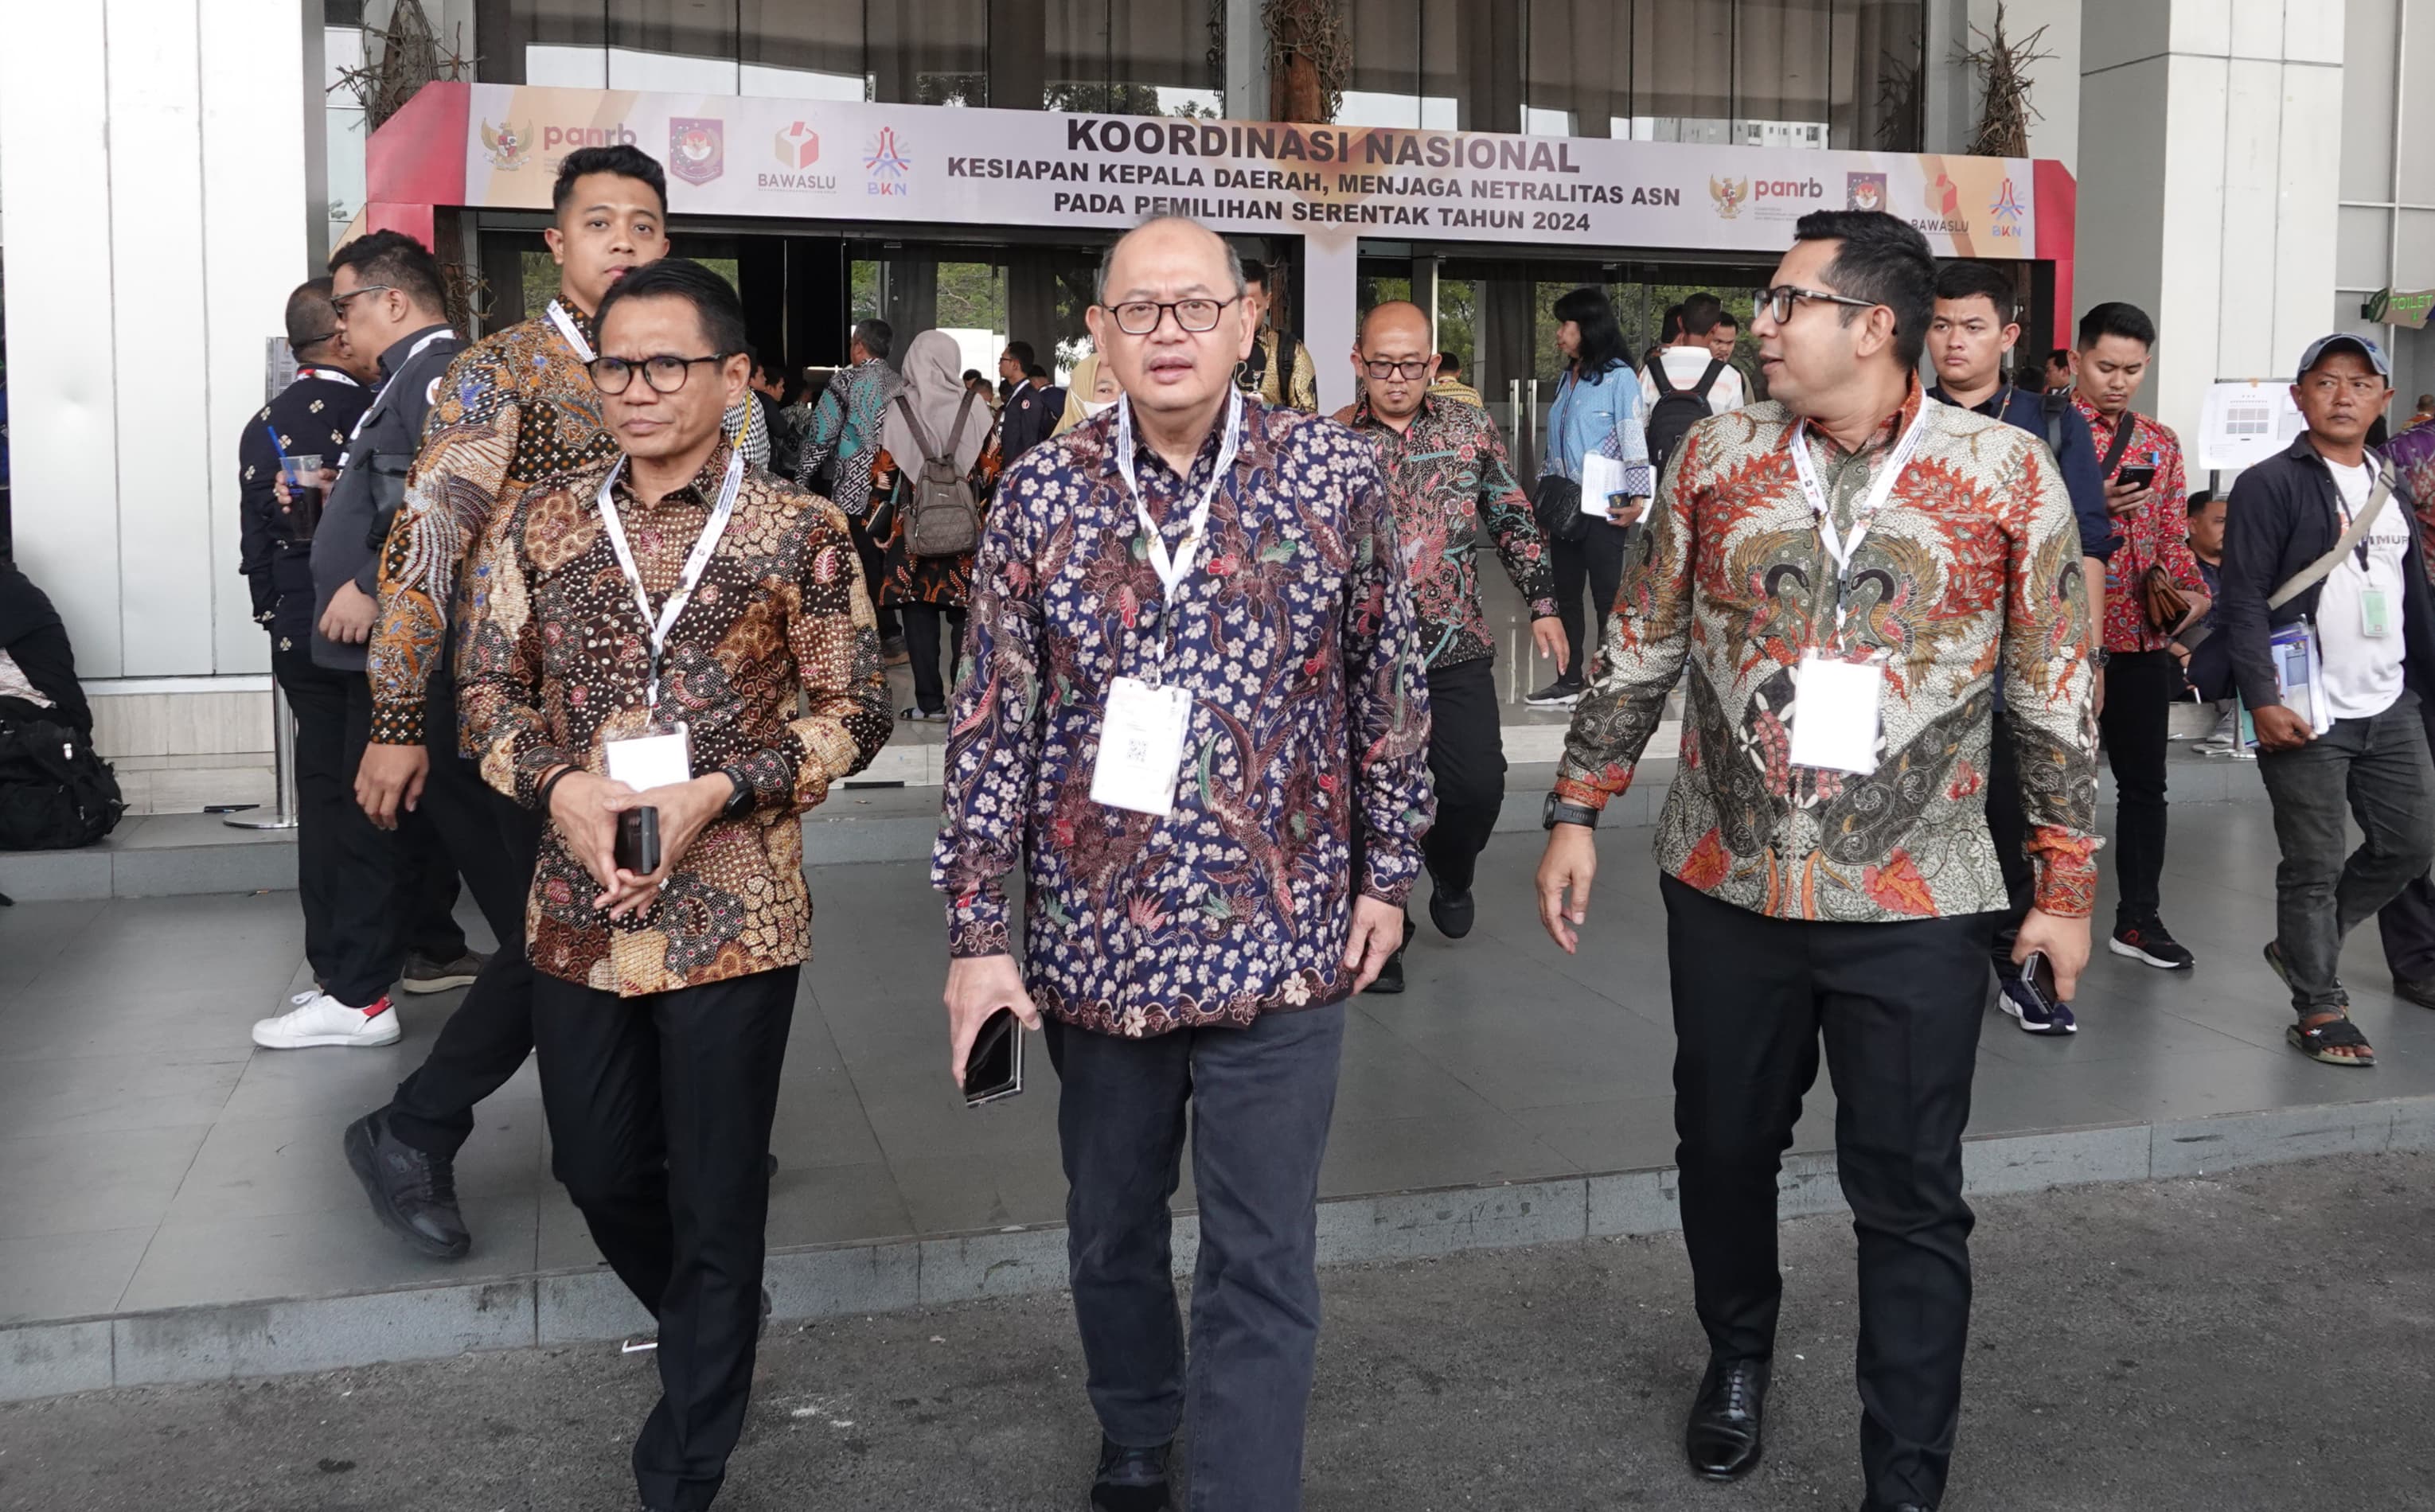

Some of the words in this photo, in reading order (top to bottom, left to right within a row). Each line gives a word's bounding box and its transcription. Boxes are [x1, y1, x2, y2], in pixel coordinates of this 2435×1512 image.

[544, 123, 637, 150] panrb
[1067, 119, 1348, 162] KOORDINASI
[1366, 134, 1580, 173] NASIONAL
[758, 173, 836, 189] BAWASLU
[868, 181, 907, 196] BKN
[947, 157, 1088, 182] KESIAPAN
[1099, 164, 1204, 187] KEPALA
[1215, 170, 1329, 195] DAERAH,
[1338, 174, 1462, 198] MENJAGA
[1472, 181, 1624, 205] NETRALITAS
[1631, 186, 1680, 206] ASN
[1755, 177, 1823, 201] panrb
[1055, 193, 1125, 214] PADA
[1134, 196, 1283, 220] PEMILIHAN
[1292, 201, 1430, 226] SERENTAK
[1438, 208, 1524, 229] TAHUN
[1533, 212, 1590, 232] 2024
[1911, 219, 1969, 232] BAWASLU
[1992, 224, 2022, 237] BKN
[2390, 294, 2433, 311] TOILET
